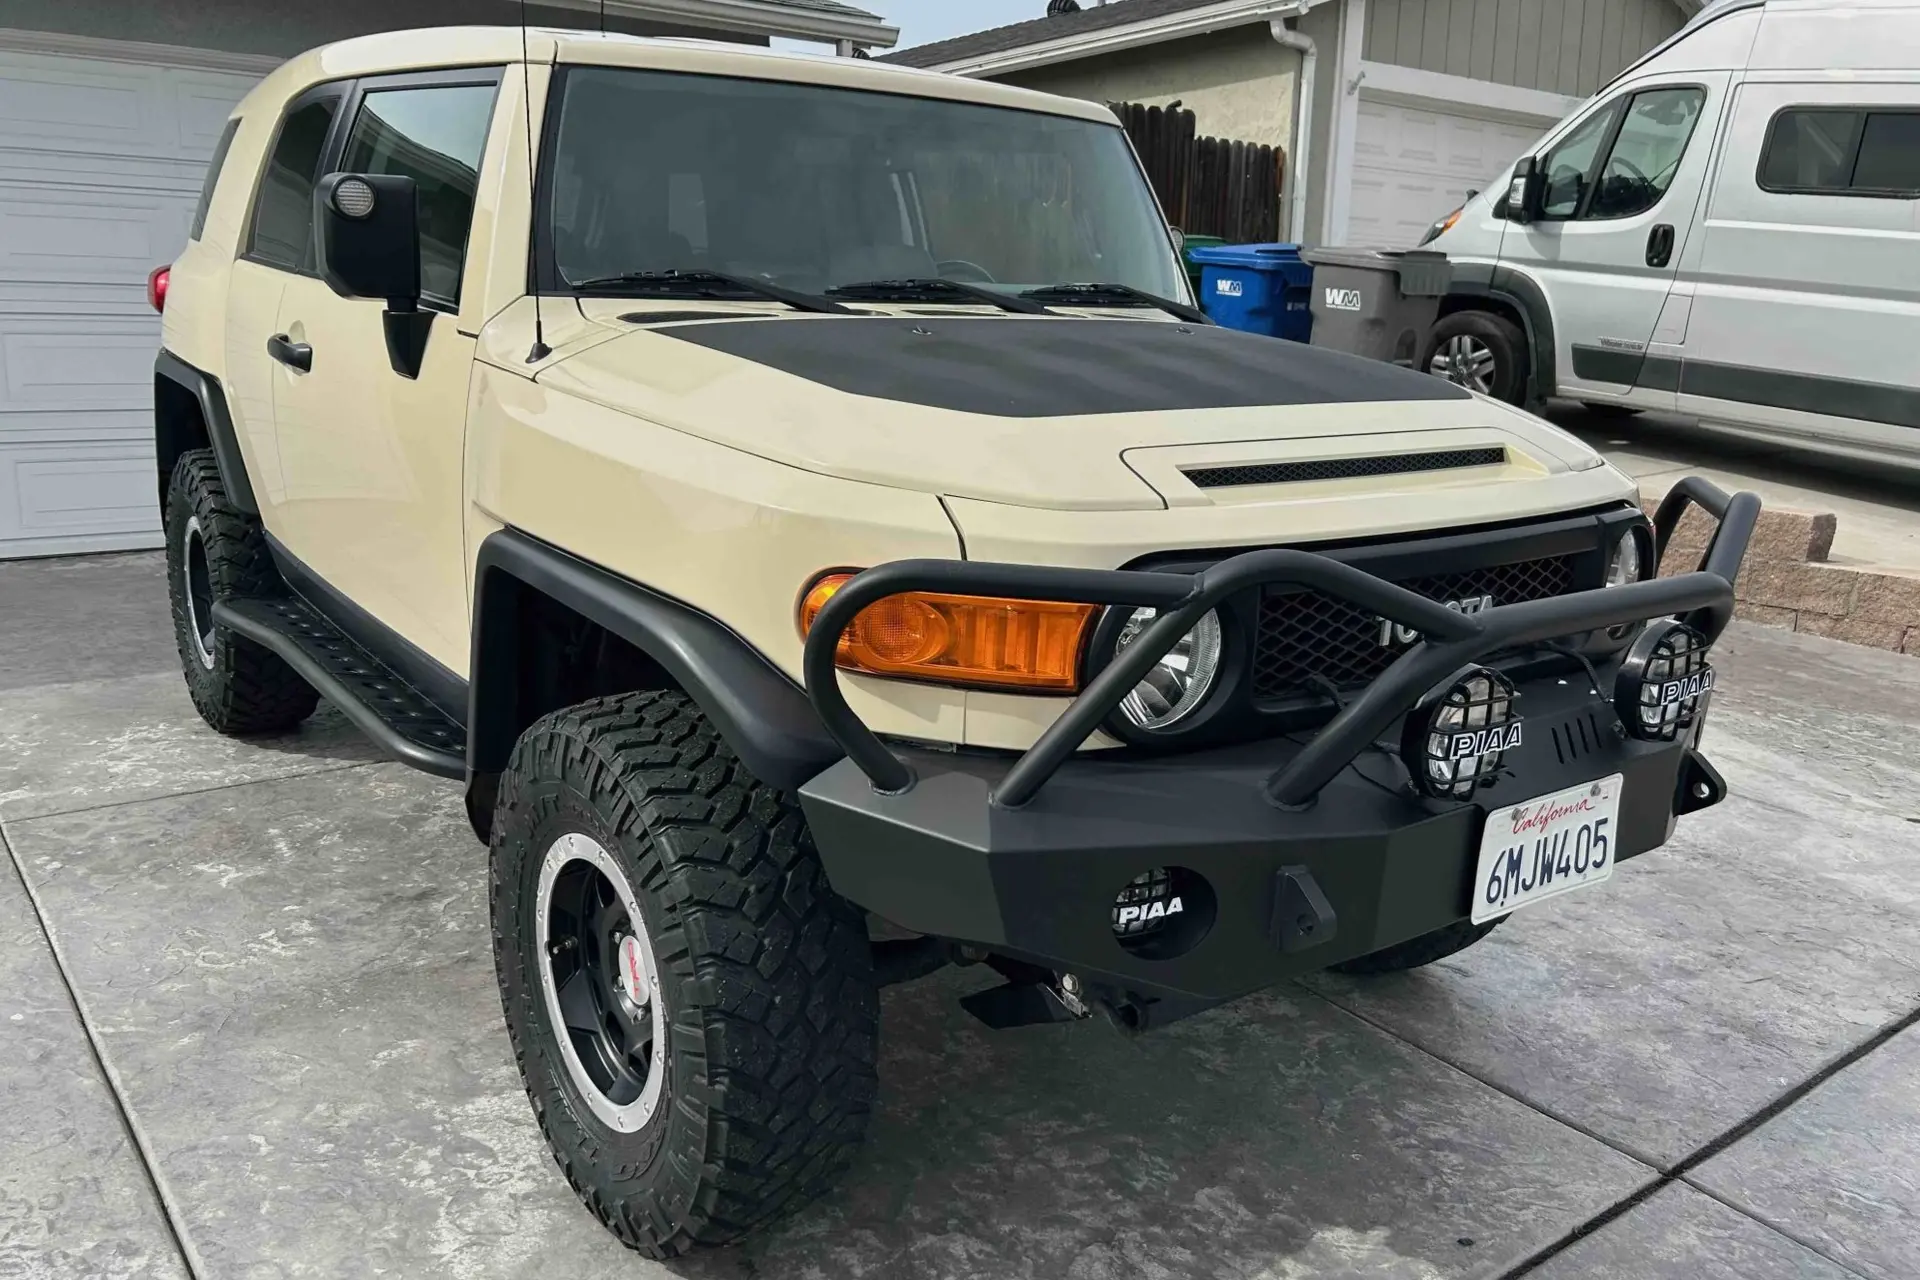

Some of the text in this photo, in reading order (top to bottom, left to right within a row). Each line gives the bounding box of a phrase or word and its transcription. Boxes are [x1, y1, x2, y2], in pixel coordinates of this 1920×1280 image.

[1216, 279, 1242, 292] WM
[1325, 288, 1360, 306] WM
[1661, 669, 1712, 705] PIAA
[1449, 722, 1522, 760] PIAA
[1512, 799, 1595, 834] California
[1486, 817, 1608, 904] 6MJW405
[1118, 896, 1183, 924] PIAA
